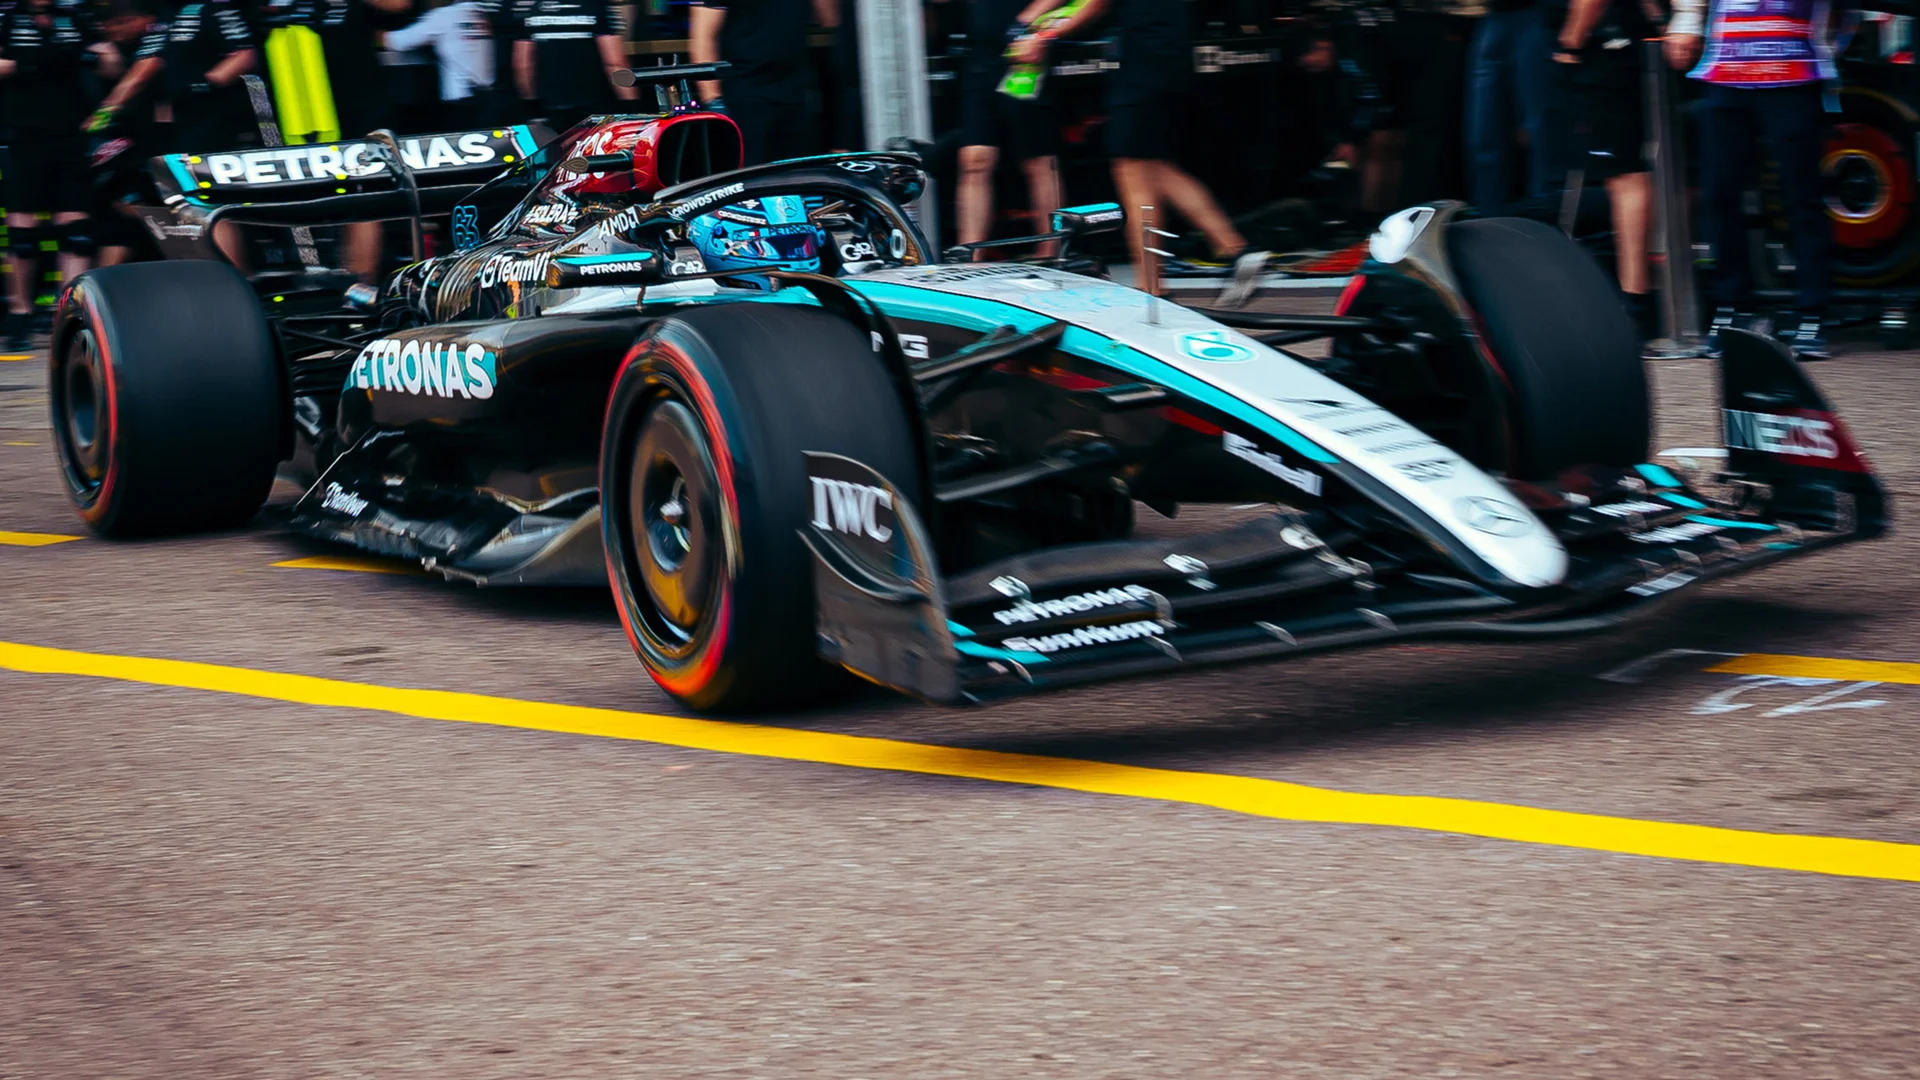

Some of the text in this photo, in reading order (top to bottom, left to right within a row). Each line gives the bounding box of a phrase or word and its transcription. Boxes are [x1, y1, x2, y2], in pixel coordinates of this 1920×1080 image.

[671, 182, 744, 218] CROWDSTRIKE
[452, 205, 480, 251] 63
[598, 209, 631, 240] AMD
[497, 252, 550, 283] TeamVi
[580, 262, 642, 275] PETRONAS
[809, 476, 892, 543] IWC
